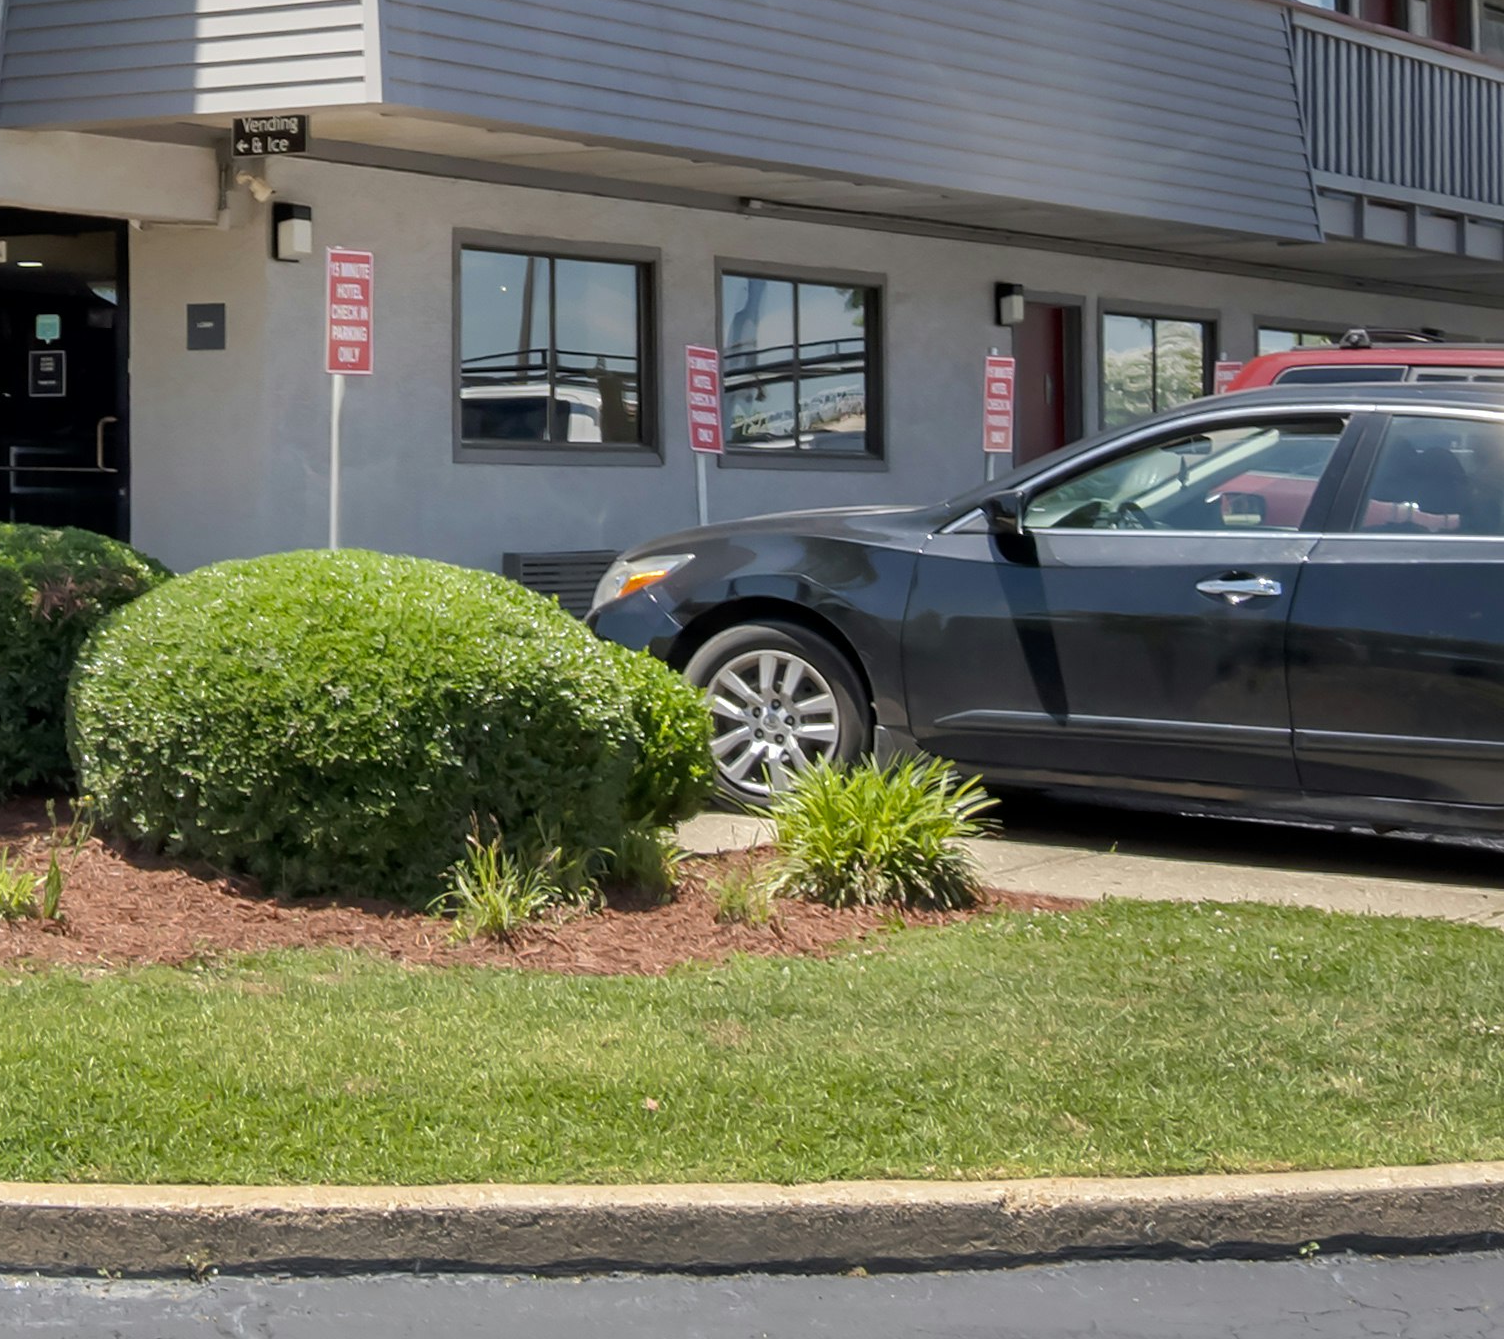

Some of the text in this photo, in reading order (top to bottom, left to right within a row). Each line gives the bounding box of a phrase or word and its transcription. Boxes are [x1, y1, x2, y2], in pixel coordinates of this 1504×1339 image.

[241, 115, 299, 134] Vending
[252, 136, 289, 153] & Ice
[336, 283, 363, 300] HOTEL
[332, 304, 358, 320] CHECK
[332, 325, 367, 342] PARKING
[338, 346, 360, 363] ONLY
